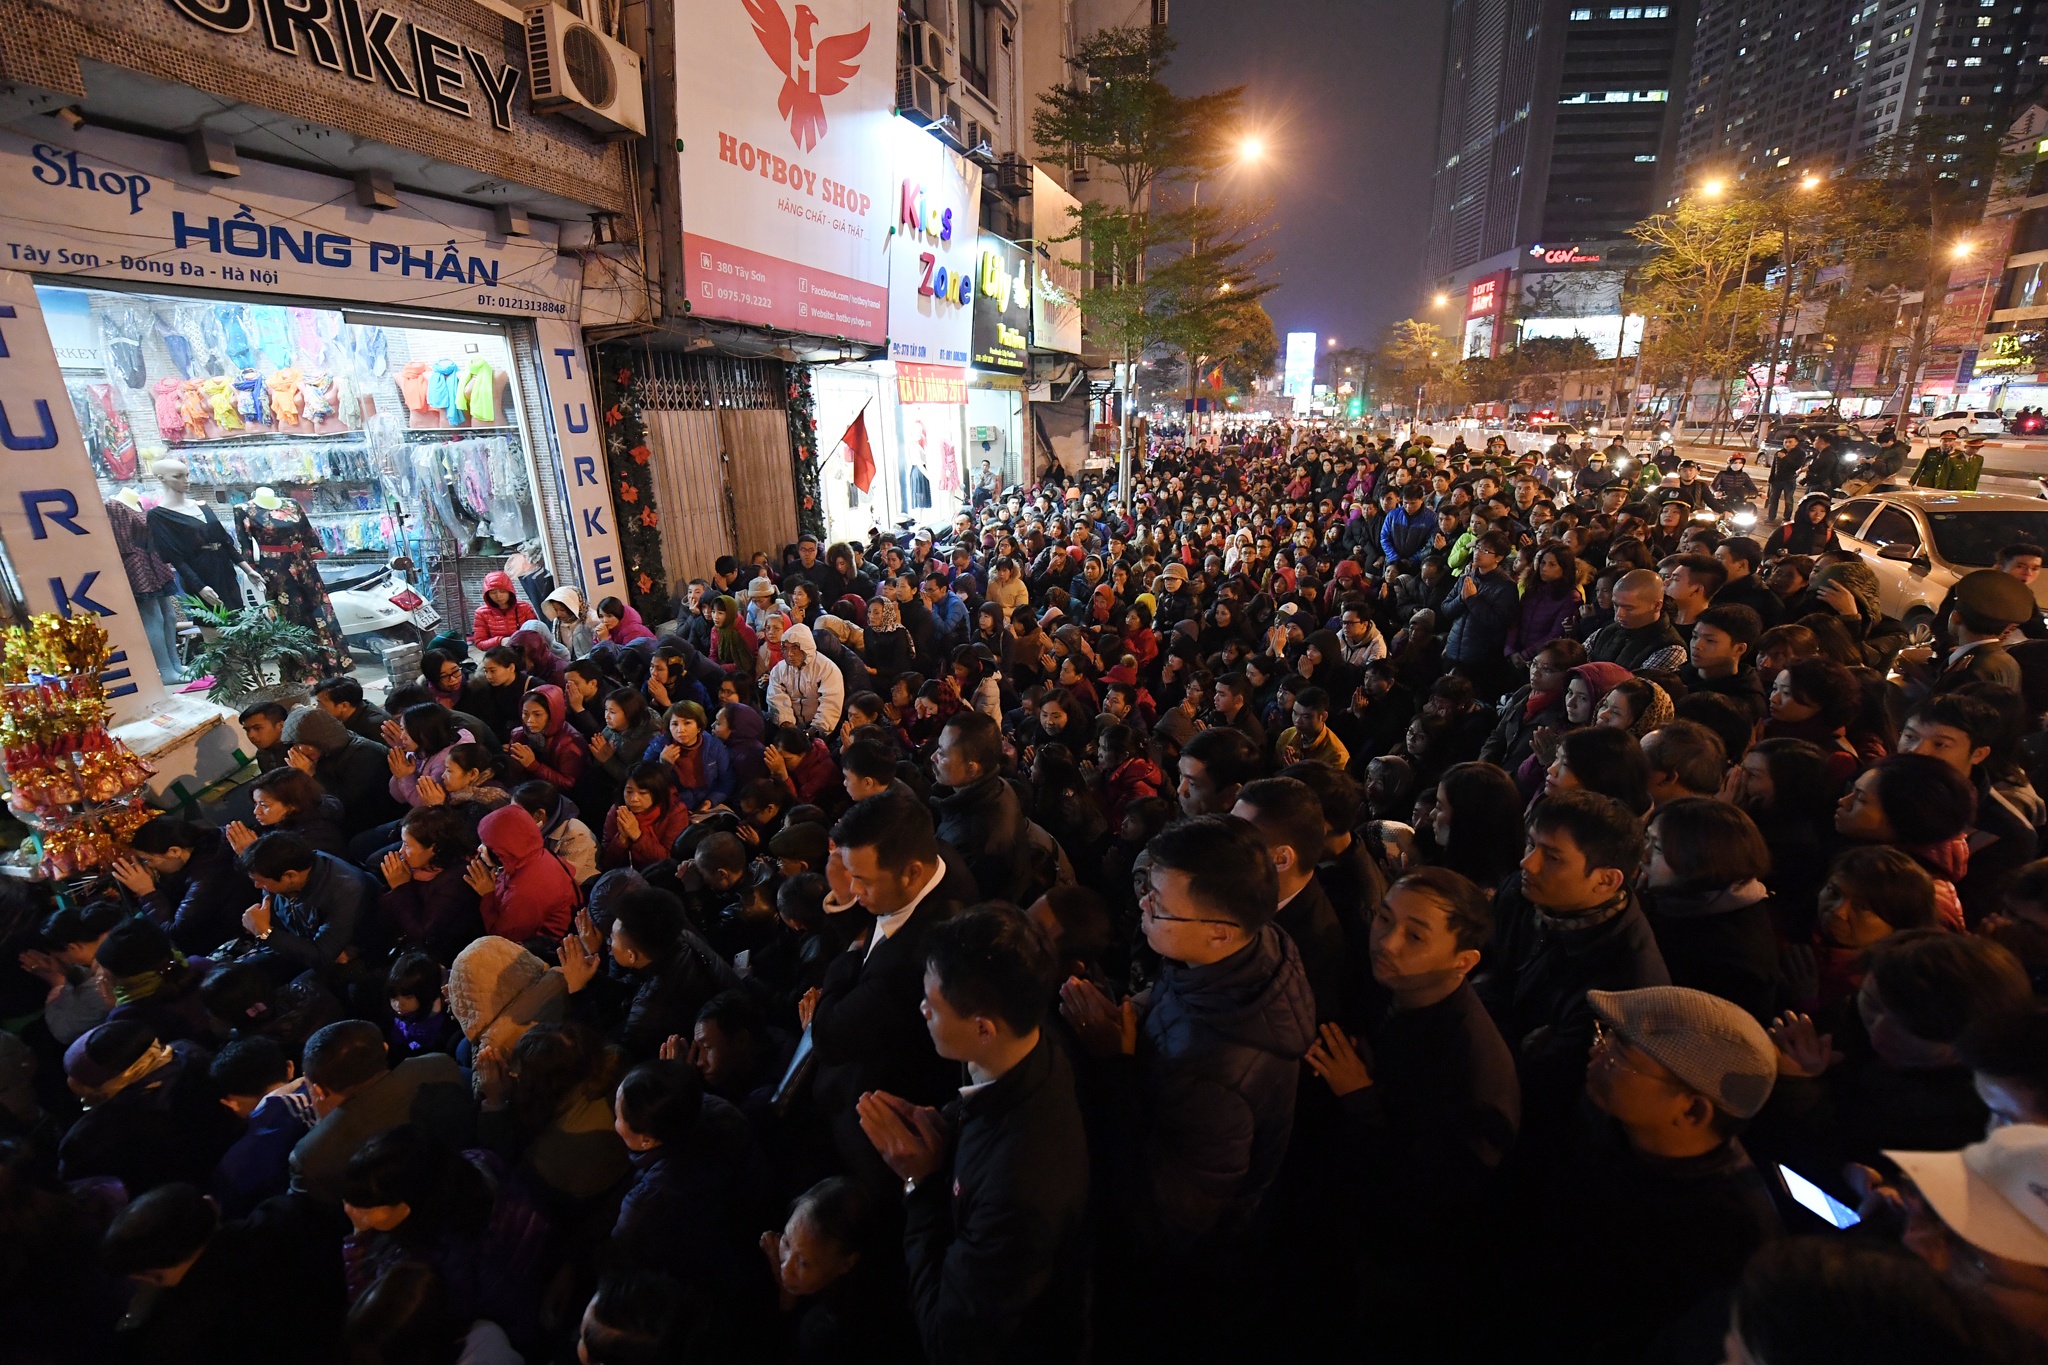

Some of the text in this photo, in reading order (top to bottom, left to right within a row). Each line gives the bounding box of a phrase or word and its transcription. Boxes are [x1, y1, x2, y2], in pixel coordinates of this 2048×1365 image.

[31, 143, 151, 215] Shop
[718, 131, 871, 217] HOTBOY SHOP
[777, 198, 804, 217] HÀNG
[805, 209, 827, 226] CHẤT
[832, 219, 846, 233] GIÁ
[848, 224, 864, 240] THẬT
[172, 203, 499, 287] HỒNG PHẤN
[1544, 249, 1575, 264] CGV
[7, 242, 50, 265] Tây
[58, 247, 101, 268] Sơn
[179, 261, 204, 278] Đa
[222, 265, 245, 281] Hà
[250, 269, 279, 285] Nội
[717, 261, 766, 283] 380 Tây Sơn
[918, 251, 972, 305] Zone
[478, 294, 566, 314] ĐT: 01213138848
[717, 287, 773, 309] 0975.79.2222
[1471, 292, 1493, 313] Mart
[1473, 280, 1496, 297] LOTTE
[811, 307, 835, 321] Website:
[553, 348, 615, 586] TURKE
